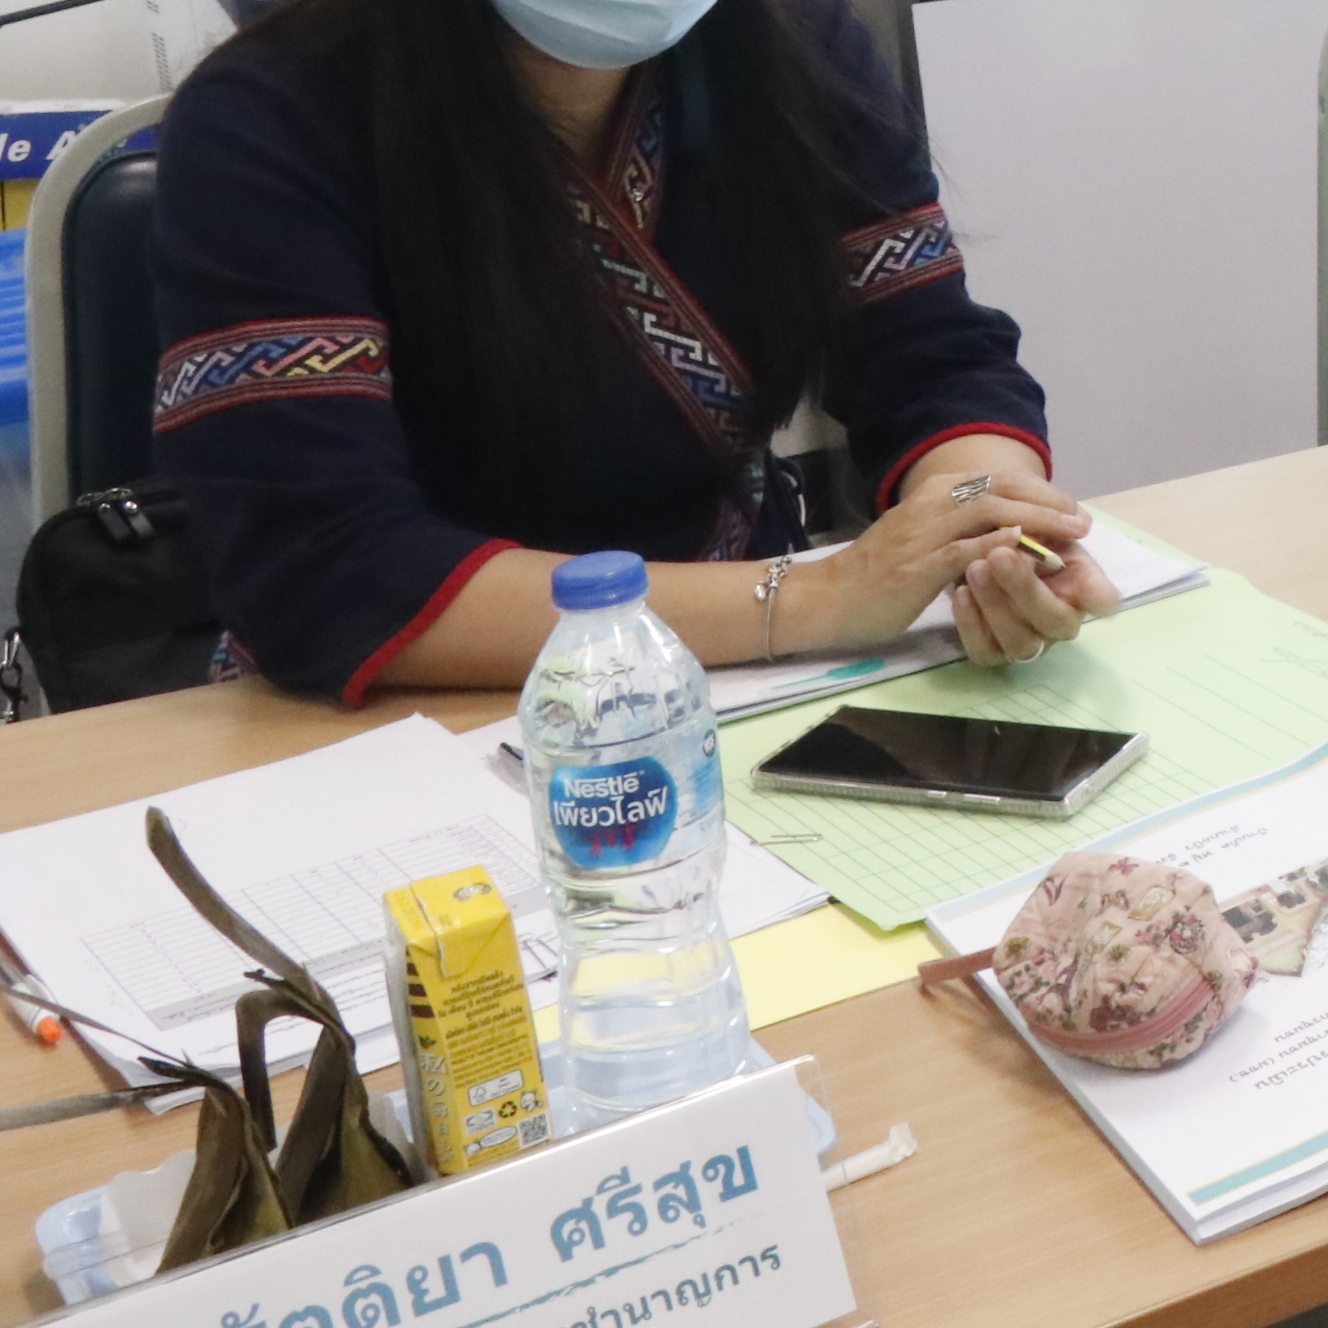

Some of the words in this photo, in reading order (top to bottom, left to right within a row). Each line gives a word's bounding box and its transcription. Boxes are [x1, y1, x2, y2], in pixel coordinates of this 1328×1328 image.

[554, 786, 668, 828] เพียวไลฟ์
[550, 1144, 758, 1263] ศรีสุข
